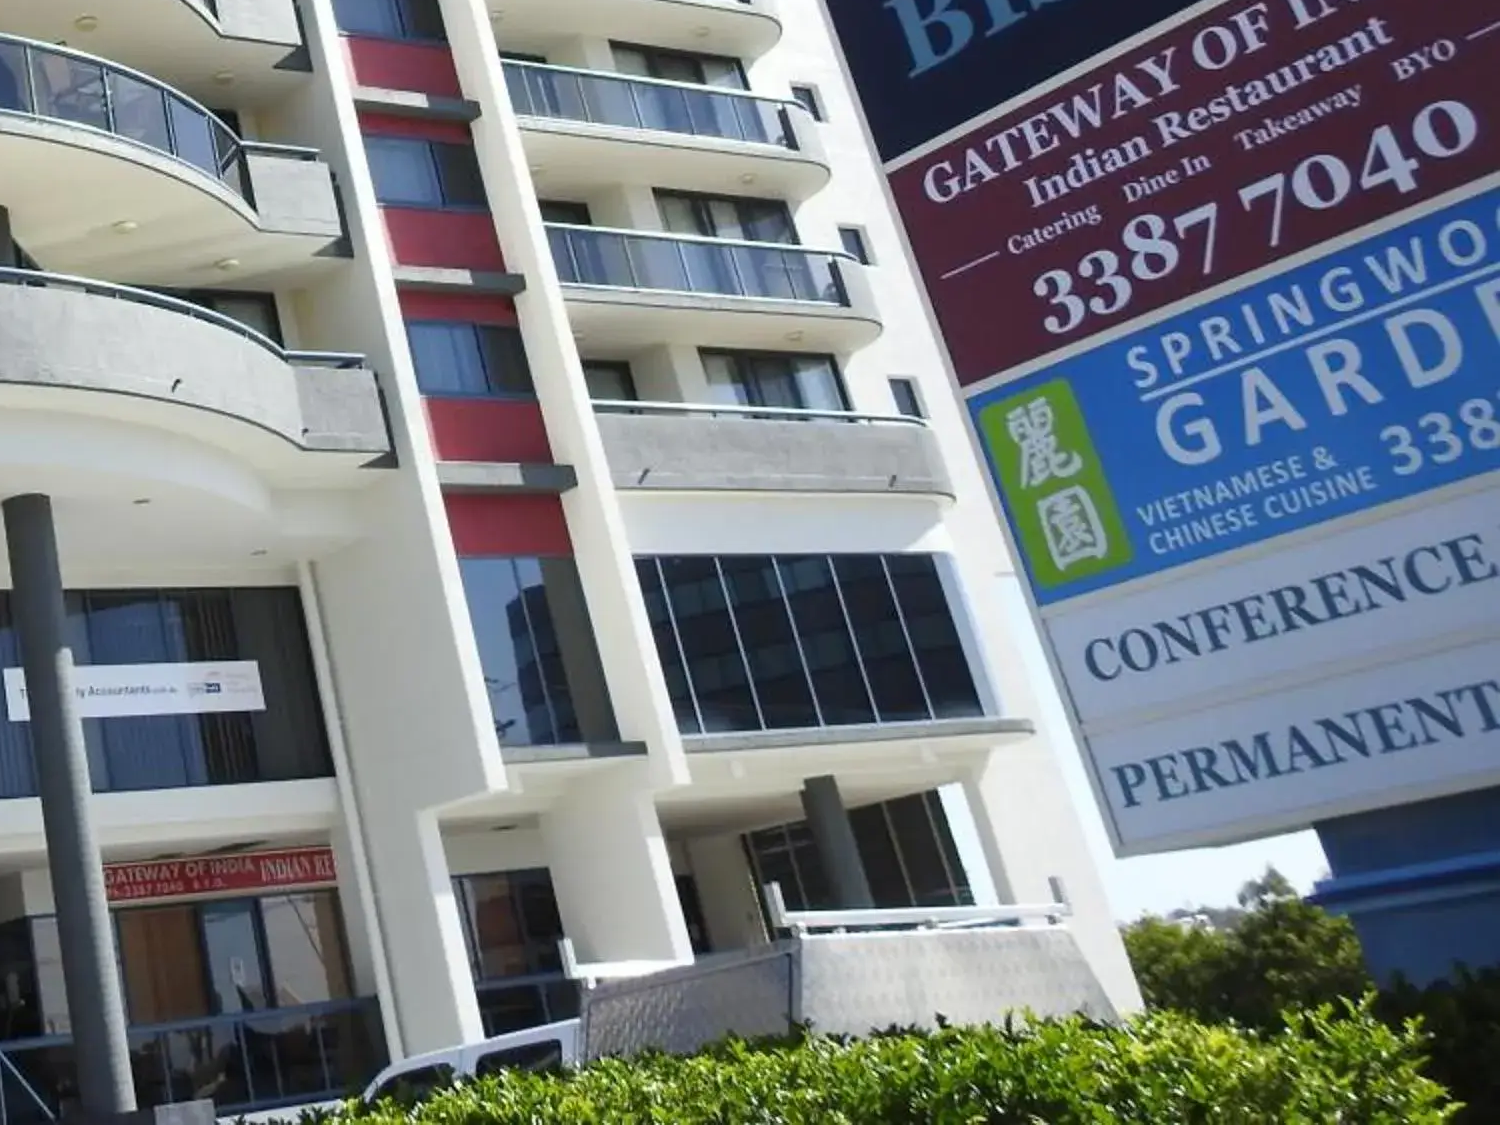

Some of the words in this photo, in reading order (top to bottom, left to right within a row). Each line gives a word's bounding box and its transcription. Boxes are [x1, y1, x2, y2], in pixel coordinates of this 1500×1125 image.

[922, 47, 1182, 204] GATEWAY
[1191, 4, 1274, 72] OF
[1022, 115, 1152, 208] Indian
[1157, 15, 1395, 156] Restaurant
[1391, 38, 1457, 83] BYO
[1006, 201, 1103, 257] Catering
[1122, 160, 1179, 204] Dine
[1183, 150, 1212, 178] In
[1233, 81, 1363, 152] Takeaway
[1032, 202, 1219, 336] 3387
[1237, 99, 1479, 247] 7040
[1126, 207, 1500, 389] SPRINGWO
[1004, 395, 1111, 572] 麗園
[1136, 461, 1308, 528] VIETNAMESE
[1313, 445, 1338, 471] &
[1379, 389, 1500, 476] 338
[1148, 507, 1258, 556] CHINESE
[1263, 465, 1379, 521] CUISINE
[1083, 533, 1499, 683] CONFERENCE
[1109, 679, 1500, 810] PERMANENT
[105, 861, 180, 886] GATEWAY
[185, 861, 209, 877] OF
[209, 856, 255, 875] INDIA
[259, 854, 311, 883] INDIAN
